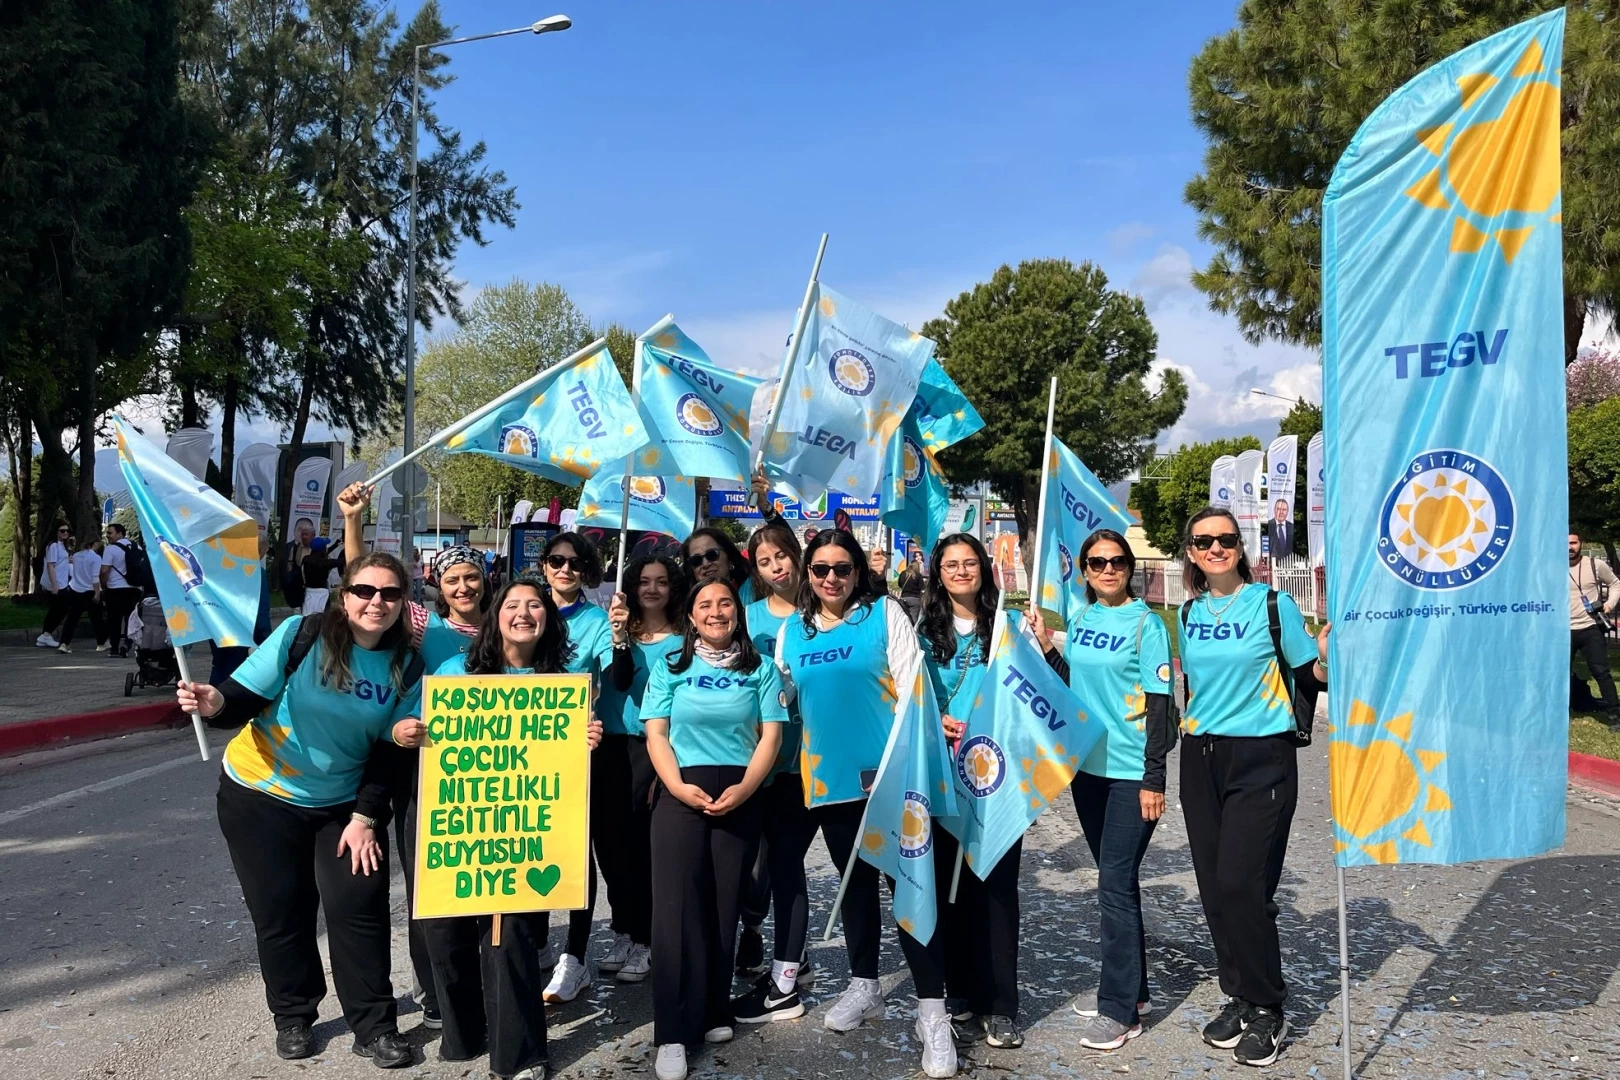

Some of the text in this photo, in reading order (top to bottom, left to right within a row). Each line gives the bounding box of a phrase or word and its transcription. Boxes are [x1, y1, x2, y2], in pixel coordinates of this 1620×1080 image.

[1385, 329, 1509, 380] TEGV
[668, 355, 725, 395] TEGV
[567, 380, 608, 440] TEGV
[1402, 453, 1476, 483] ĞİTİM
[725, 494, 745, 502] THIS
[1060, 482, 1103, 530] TEGV
[1378, 525, 1510, 586] GÖNÜLLÜLERİ
[1365, 609, 1405, 622] Çocuk
[1406, 605, 1456, 619] Değişir,
[1459, 603, 1508, 617] Türkiye
[1511, 601, 1555, 614] Gelişir.
[1071, 627, 1127, 652] TEGV
[1186, 620, 1251, 641] TEGV
[799, 646, 853, 668] TEGV
[432, 686, 588, 713] KOŞUYORUZ!
[1003, 665, 1068, 732] TEGV
[427, 712, 571, 744] ÇÜNKÜ HER
[440, 745, 529, 776] ÇOCUK
[439, 772, 561, 804] NİTELİKLİ
[430, 804, 552, 836] EĞİTİMLE
[427, 836, 544, 869] BÜYÜSÜN
[455, 867, 517, 899] DİYE
